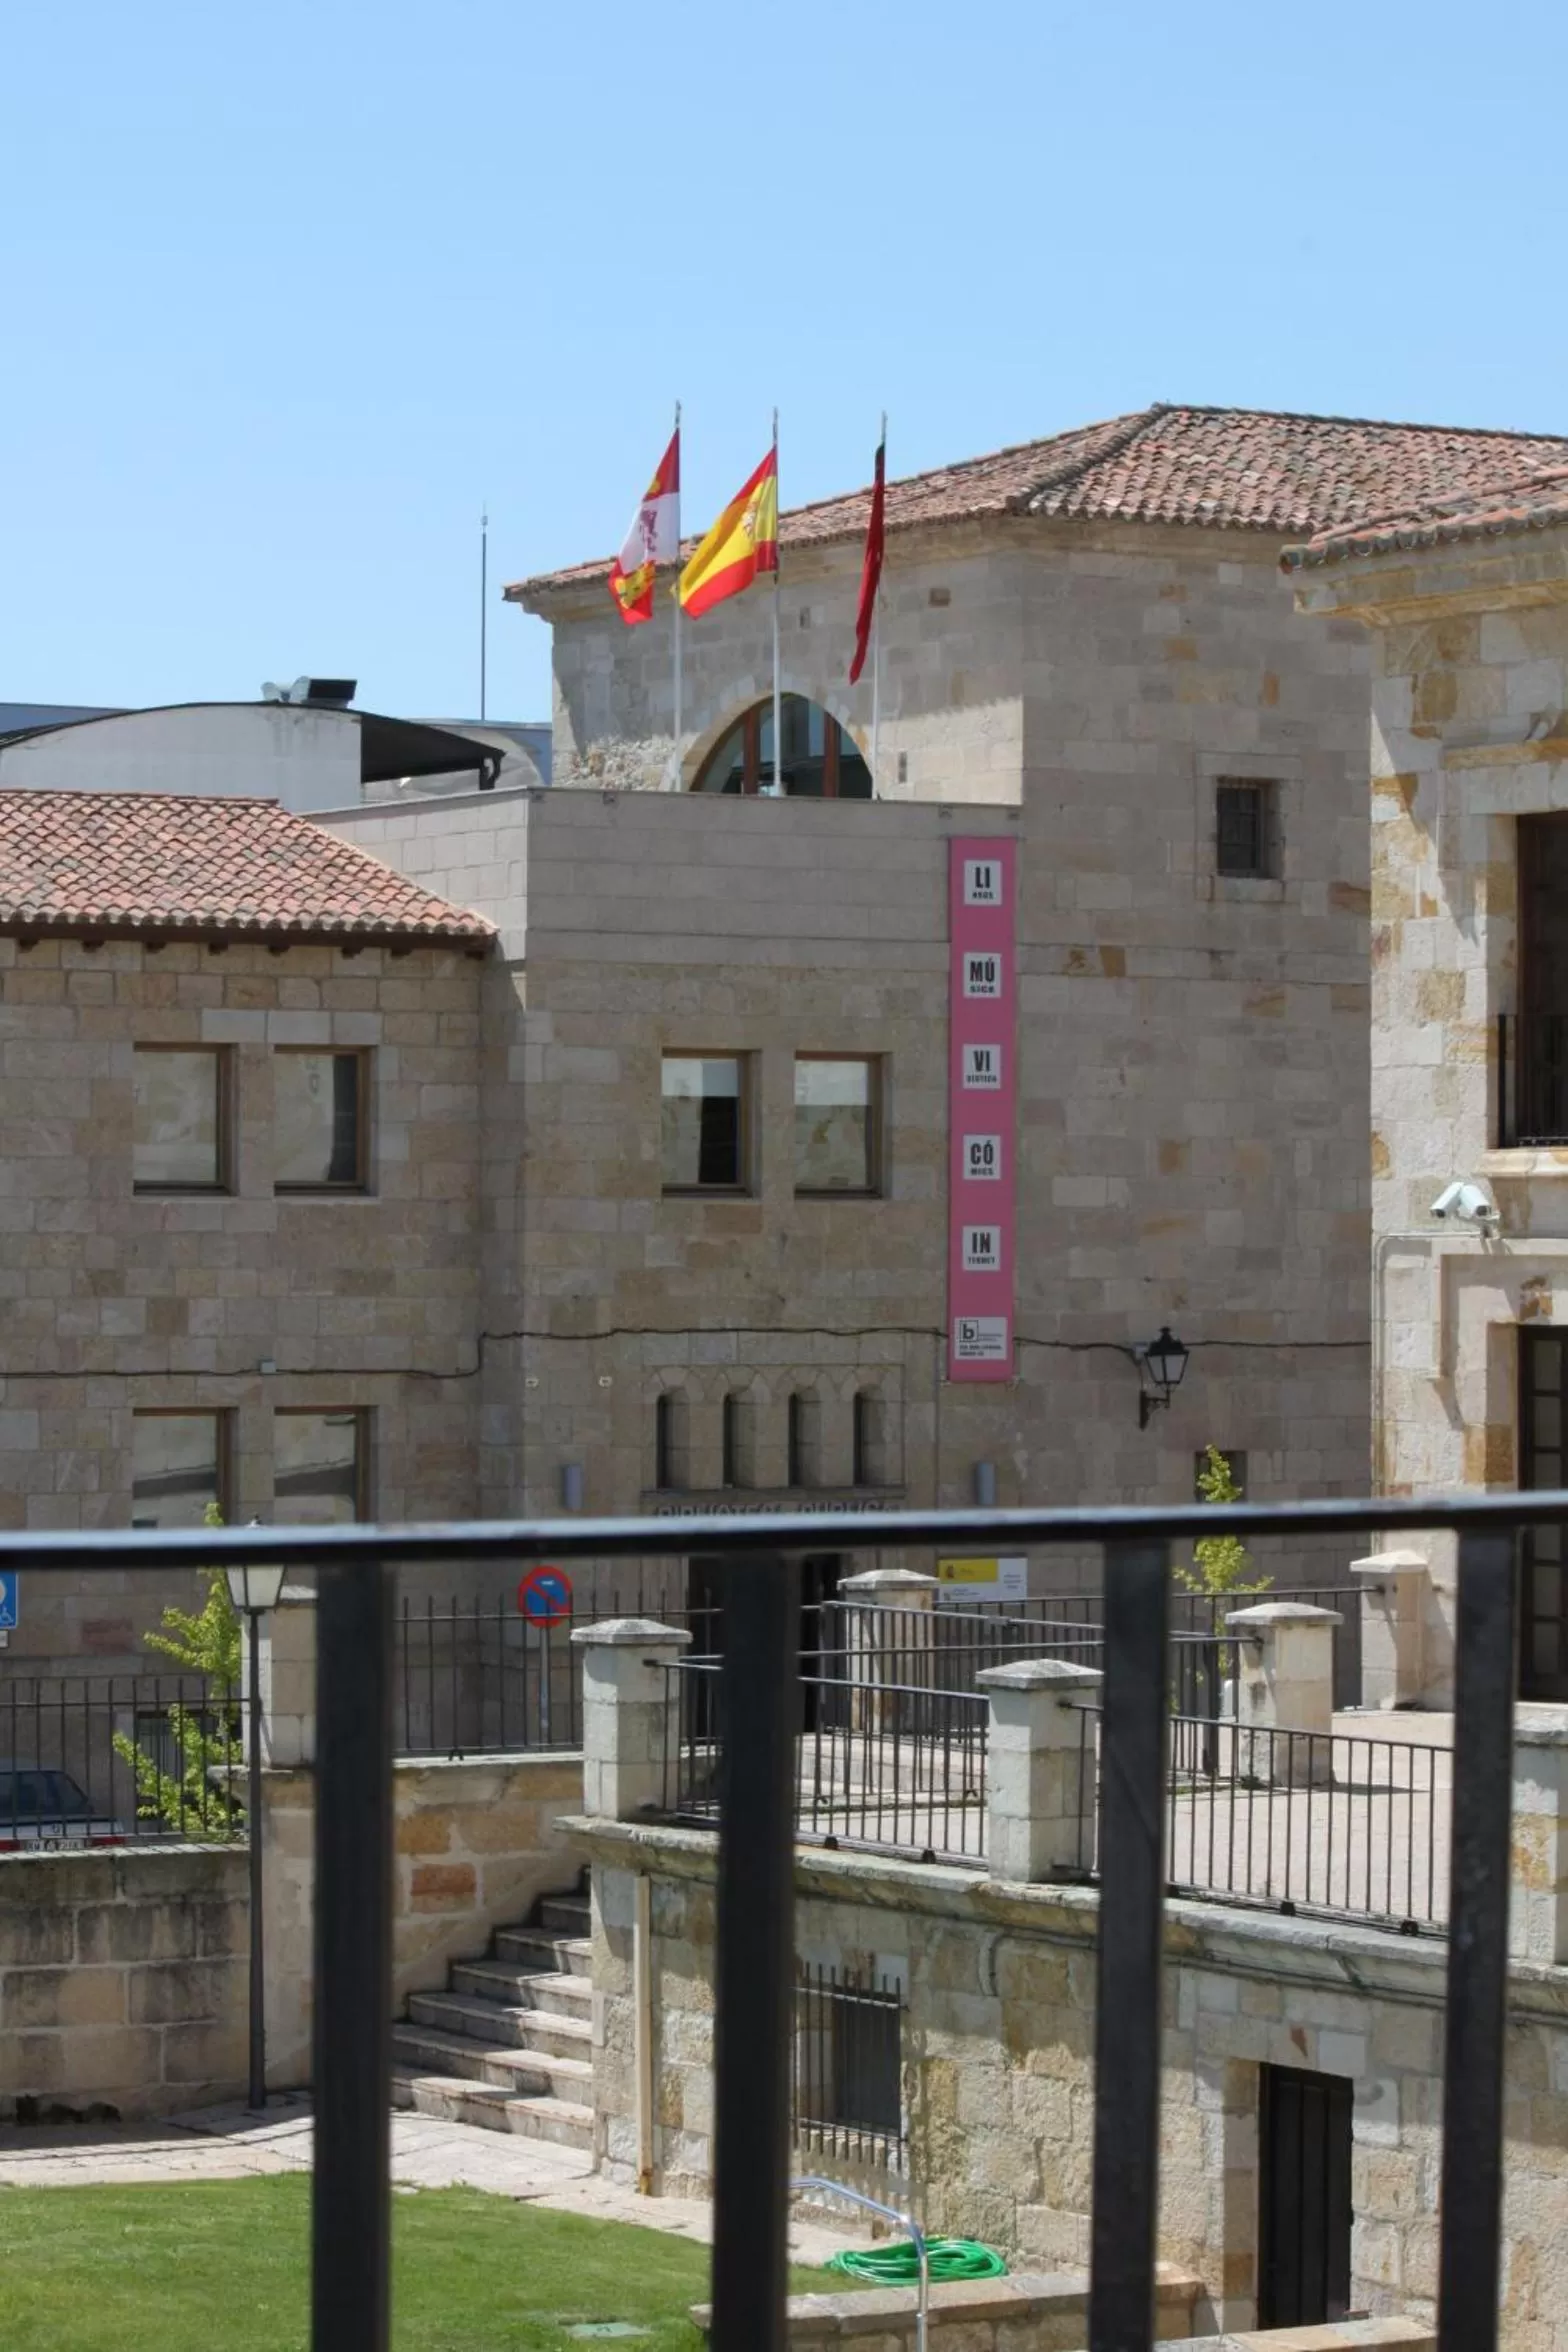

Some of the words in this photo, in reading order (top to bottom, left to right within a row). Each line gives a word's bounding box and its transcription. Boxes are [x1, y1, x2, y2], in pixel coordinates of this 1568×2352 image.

[974, 866, 990, 888] LI
[969, 957, 995, 982] MÚ
[973, 1050, 990, 1072] VI
[970, 1140, 994, 1166] CÓ
[972, 1231, 990, 1253] IN
